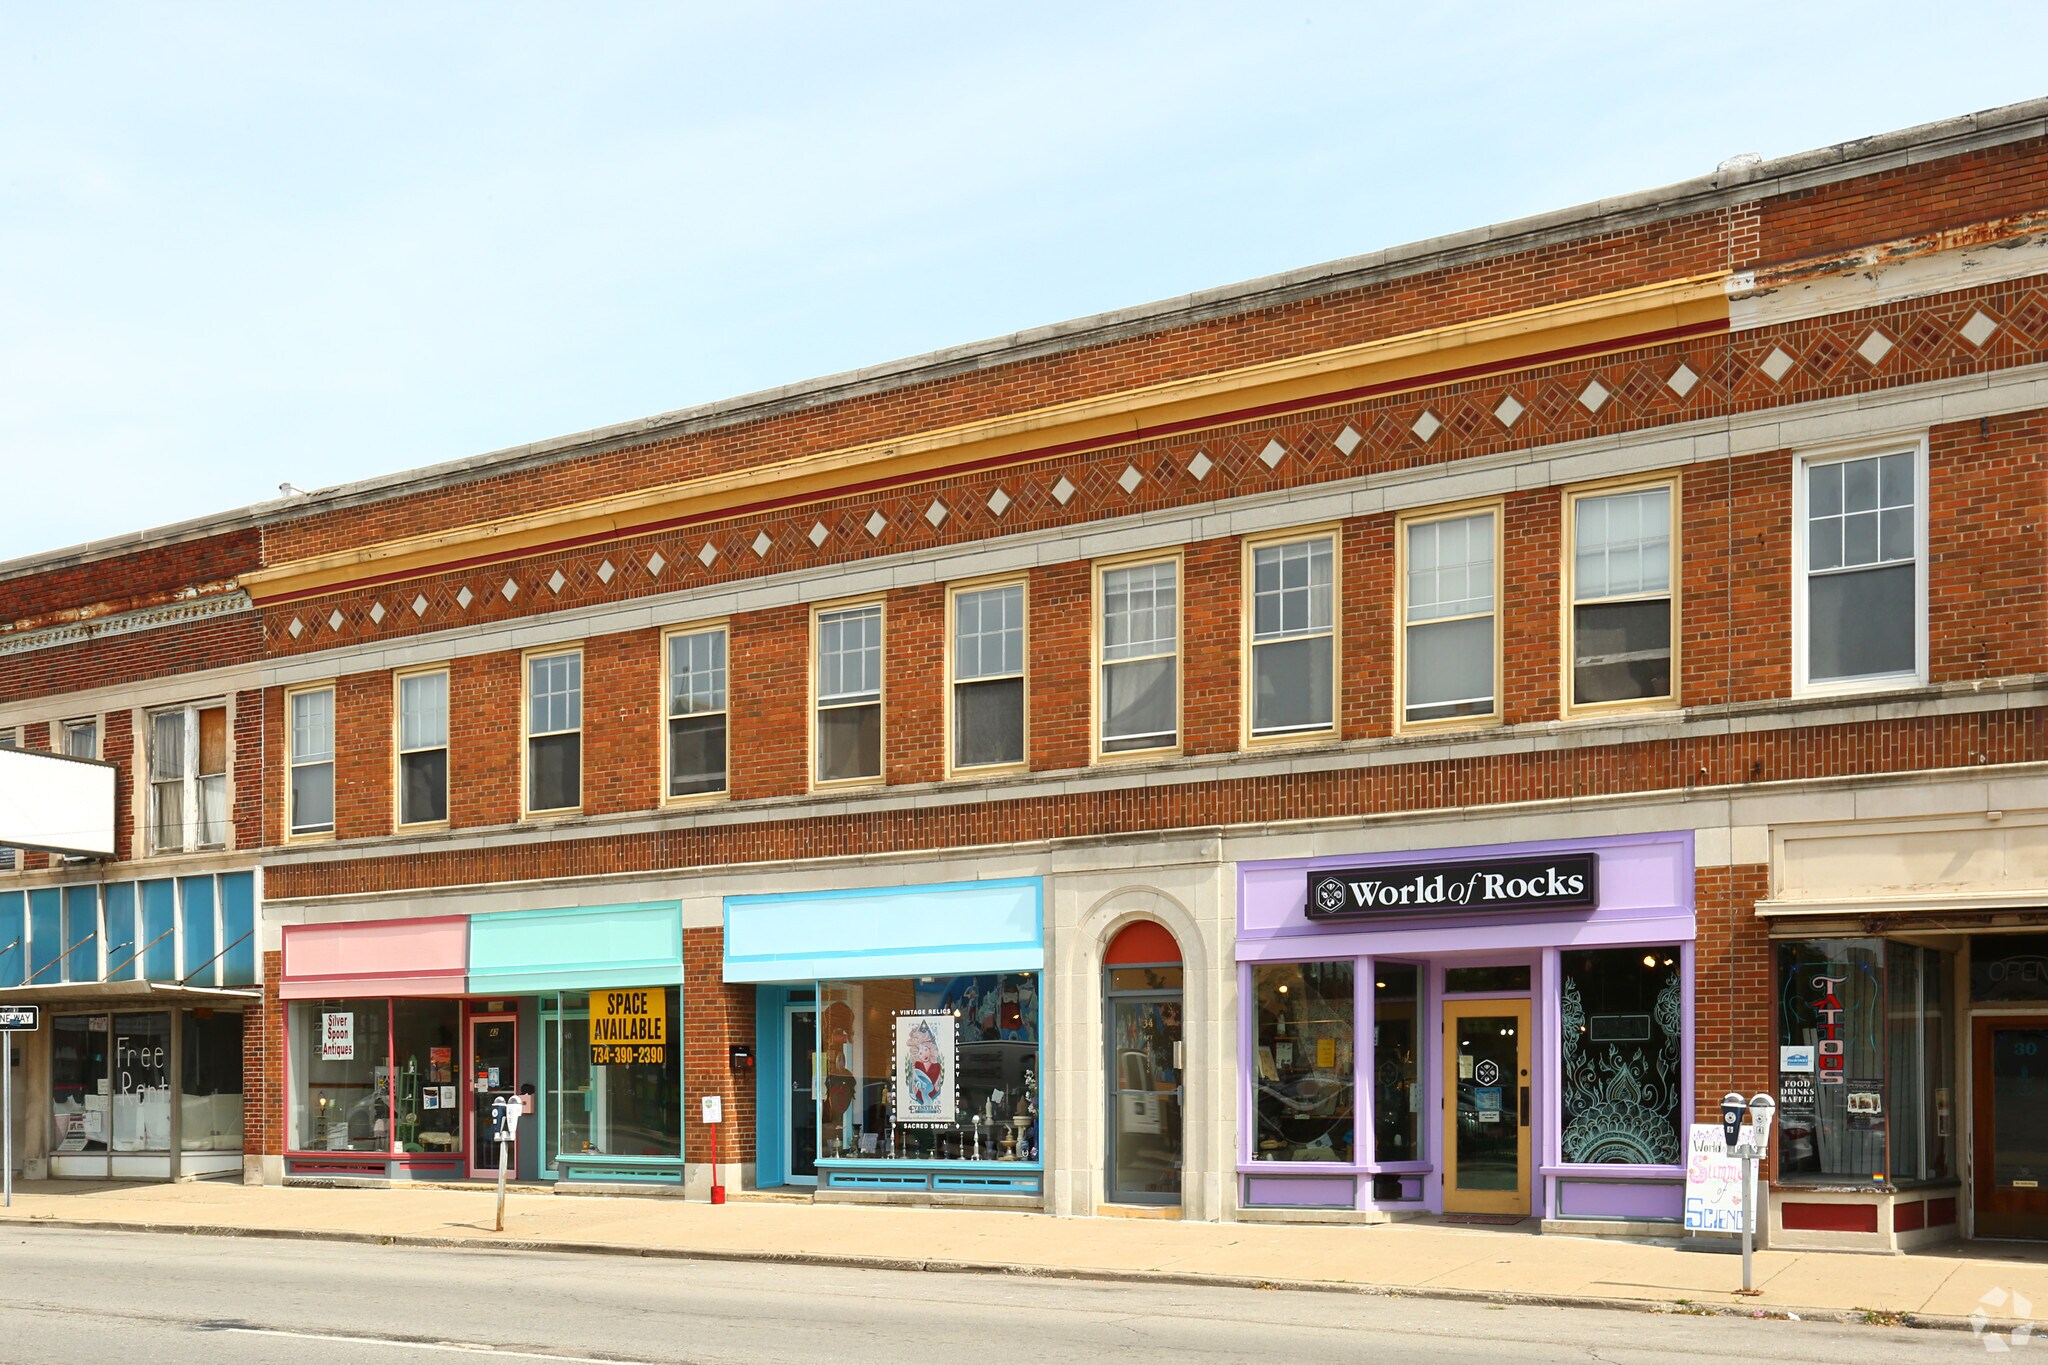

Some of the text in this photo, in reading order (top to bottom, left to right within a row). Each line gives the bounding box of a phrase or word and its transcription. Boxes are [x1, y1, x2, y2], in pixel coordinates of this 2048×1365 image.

[1349, 867, 1584, 907] World of Rocks
[607, 993, 648, 1015] SPACE
[0, 1014, 31, 1022] NE WAY
[328, 1014, 348, 1026] Silver
[1142, 1019, 1153, 1029] 34
[328, 1027, 349, 1042] Spoon
[594, 1018, 662, 1040] AVAILABLE
[1810, 976, 1848, 1085] TATTOOS
[117, 1037, 164, 1068] Free
[323, 1042, 352, 1058] Antiques
[592, 1046, 663, 1064] 734-390-2390
[2014, 1042, 2037, 1055] 30
[122, 1071, 168, 1106] Rent
[1784, 1080, 1811, 1088] FOOD
[1693, 1140, 1721, 1153] World
[1689, 1155, 1744, 1183] Summe
[1711, 1181, 1731, 1203] of
